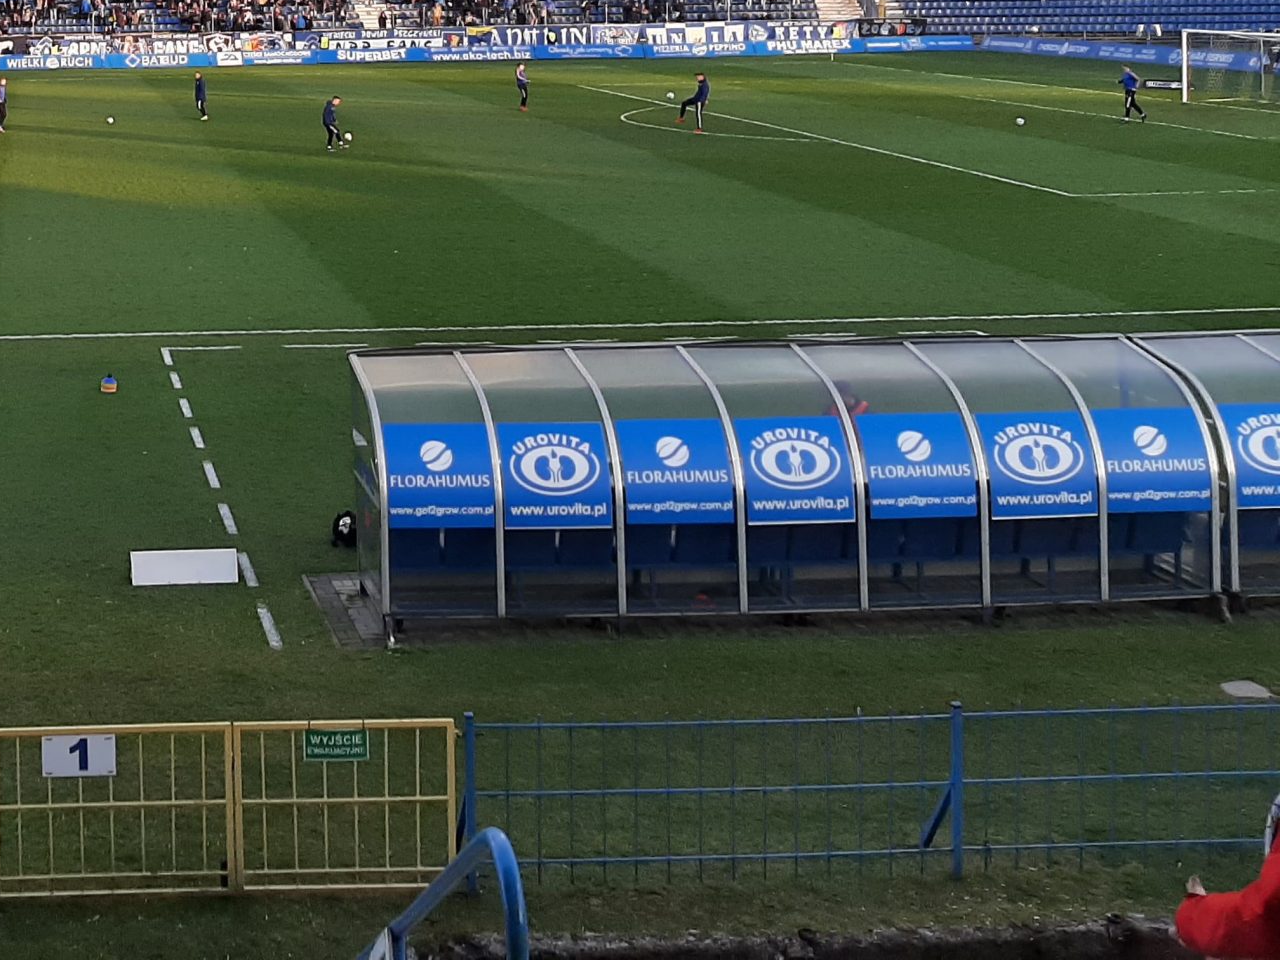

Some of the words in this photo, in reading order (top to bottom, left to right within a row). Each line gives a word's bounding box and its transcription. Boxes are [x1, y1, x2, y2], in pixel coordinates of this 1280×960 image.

[767, 41, 797, 51] PHU
[800, 39, 851, 50] MAREX
[337, 48, 407, 61] SUPERBET
[7, 57, 43, 69] WIELKI
[61, 57, 92, 67] RUCH
[751, 427, 832, 451] UROVITA
[994, 422, 1073, 445] UROVITA
[512, 433, 592, 456] UROVITA
[870, 464, 971, 479] FLORAHUMUS
[1107, 458, 1206, 473] FLORAHUMUS
[389, 474, 490, 488] FLORAHUMUS
[627, 469, 728, 484] FLORAHUMUS
[310, 733, 363, 746] WYJŚCIE
[69, 737, 89, 771] 1
